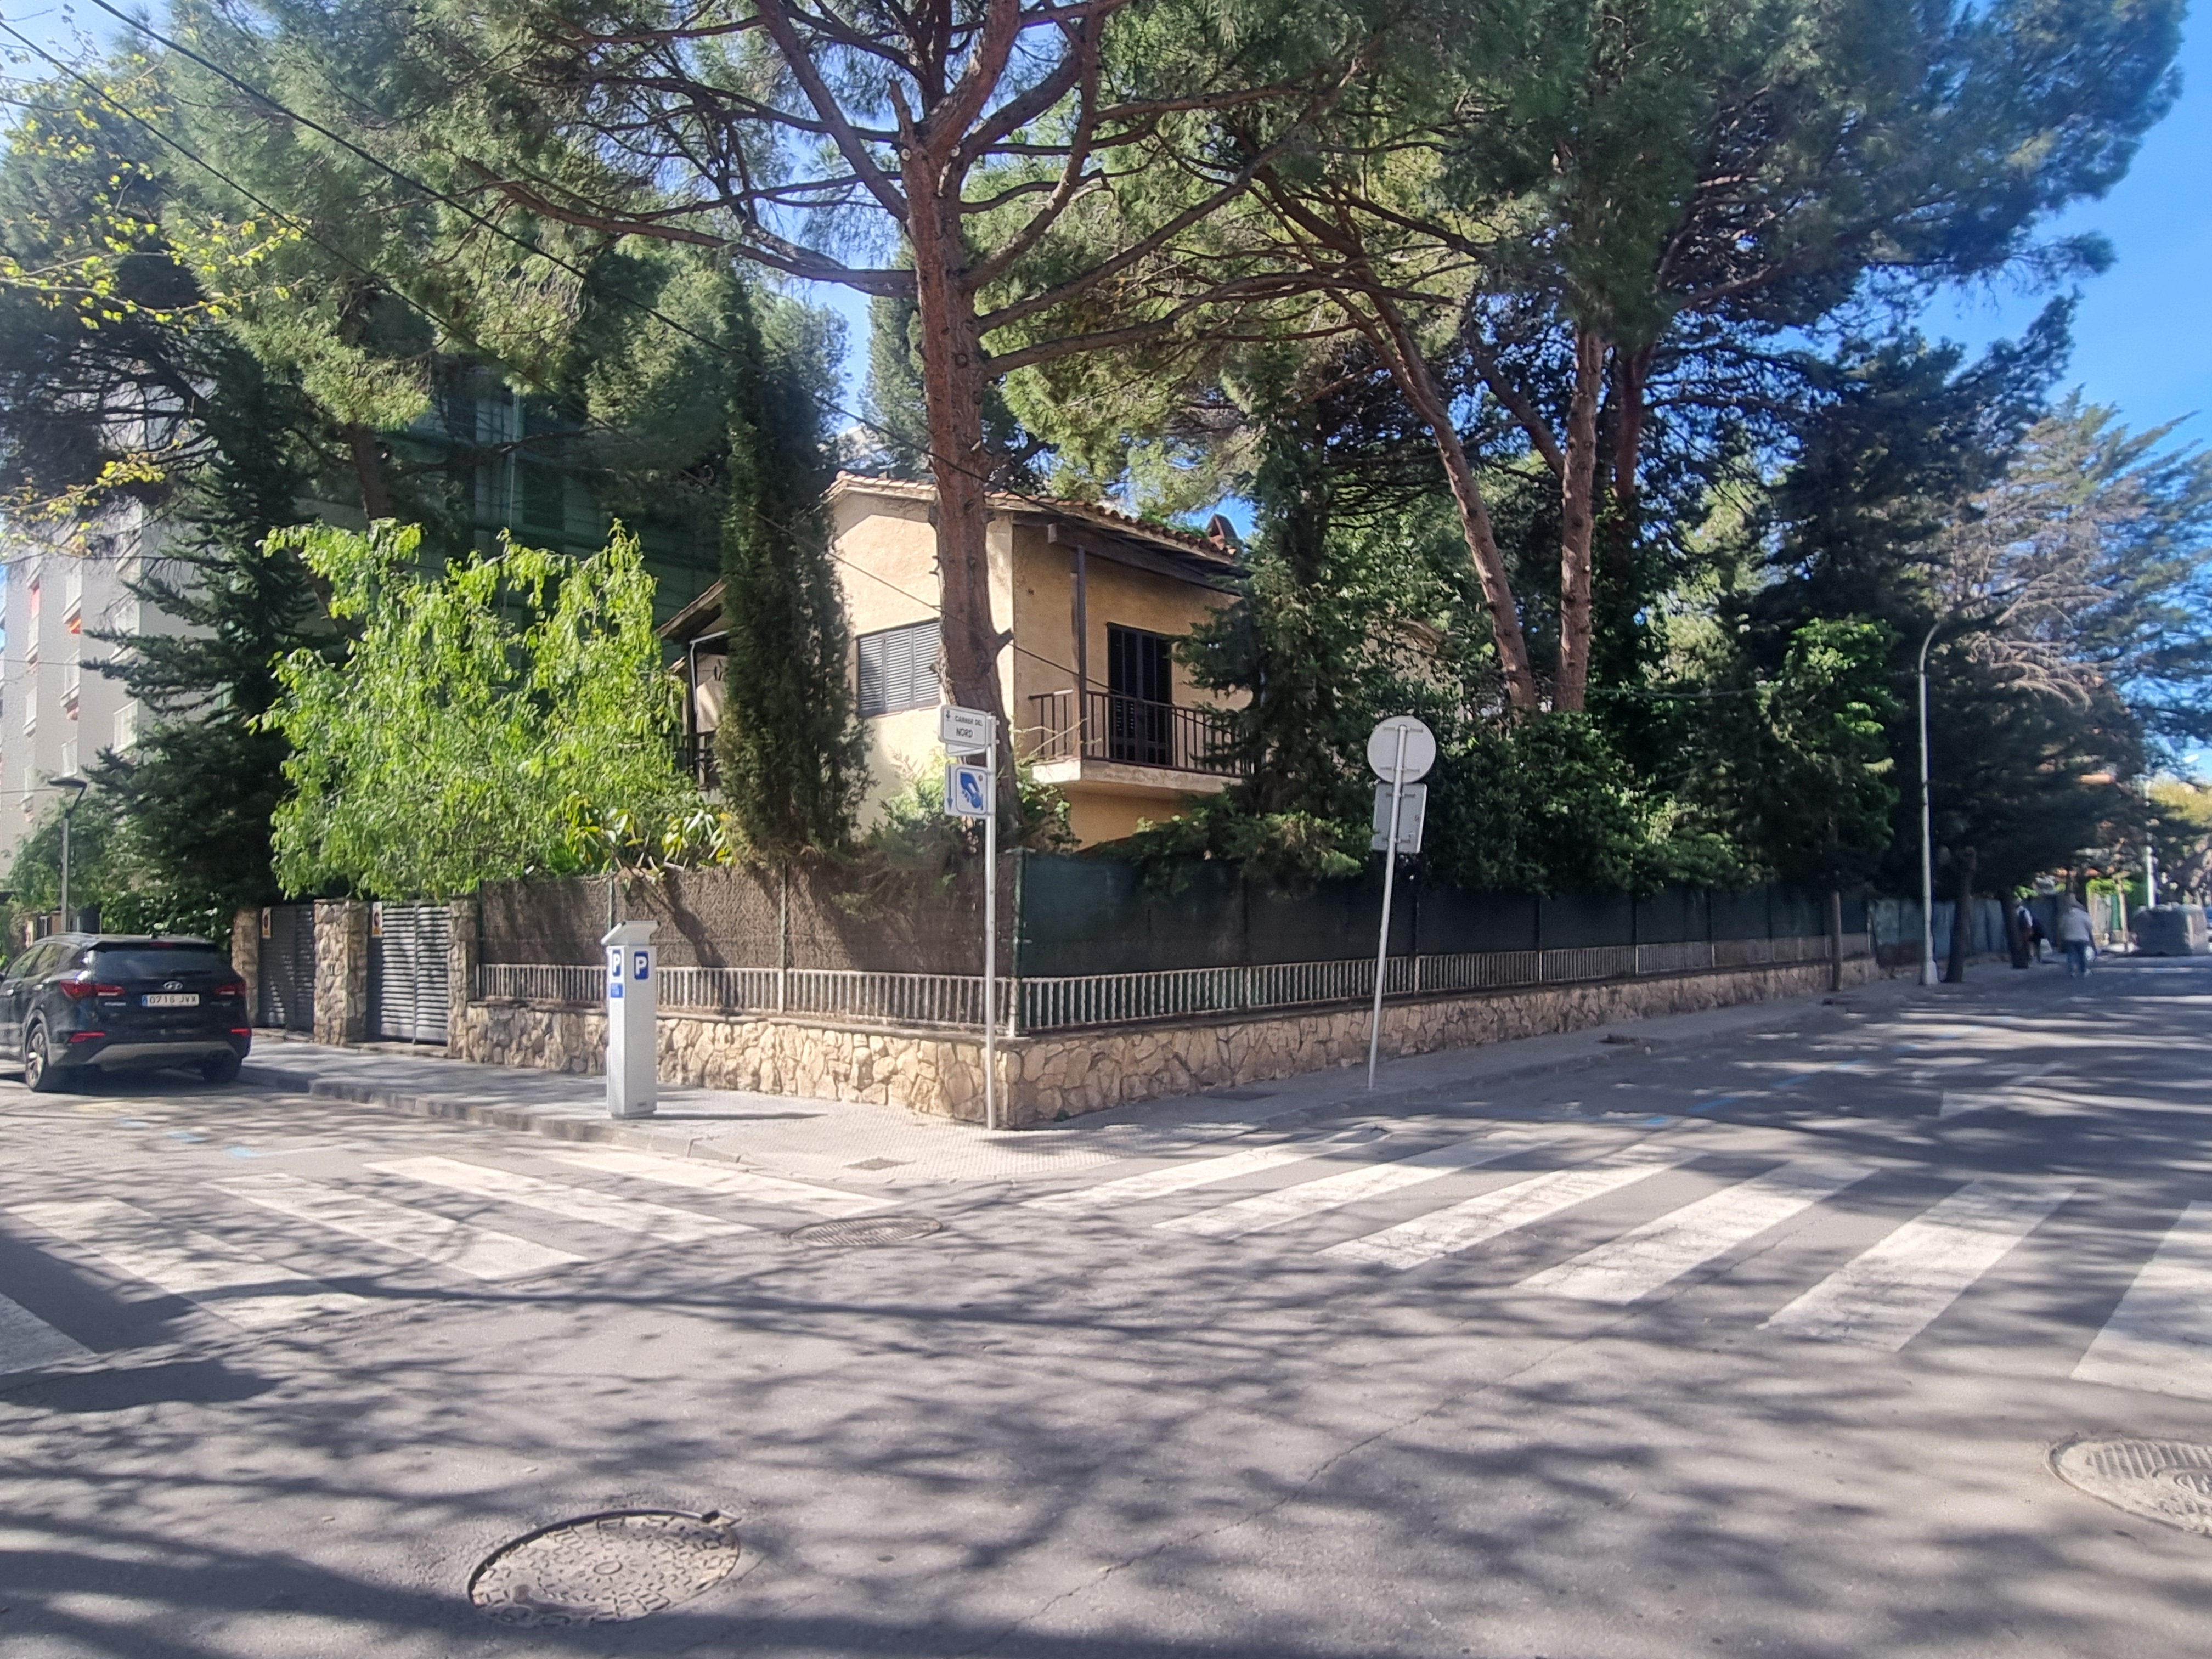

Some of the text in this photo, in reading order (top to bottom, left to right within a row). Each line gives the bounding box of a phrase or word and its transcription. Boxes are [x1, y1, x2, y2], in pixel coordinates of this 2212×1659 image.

[955, 715, 973, 725] CARRER
[956, 727, 973, 738] NORD
[613, 953, 620, 973] P
[636, 956, 647, 975] P
[149, 995, 175, 1003] 0716
